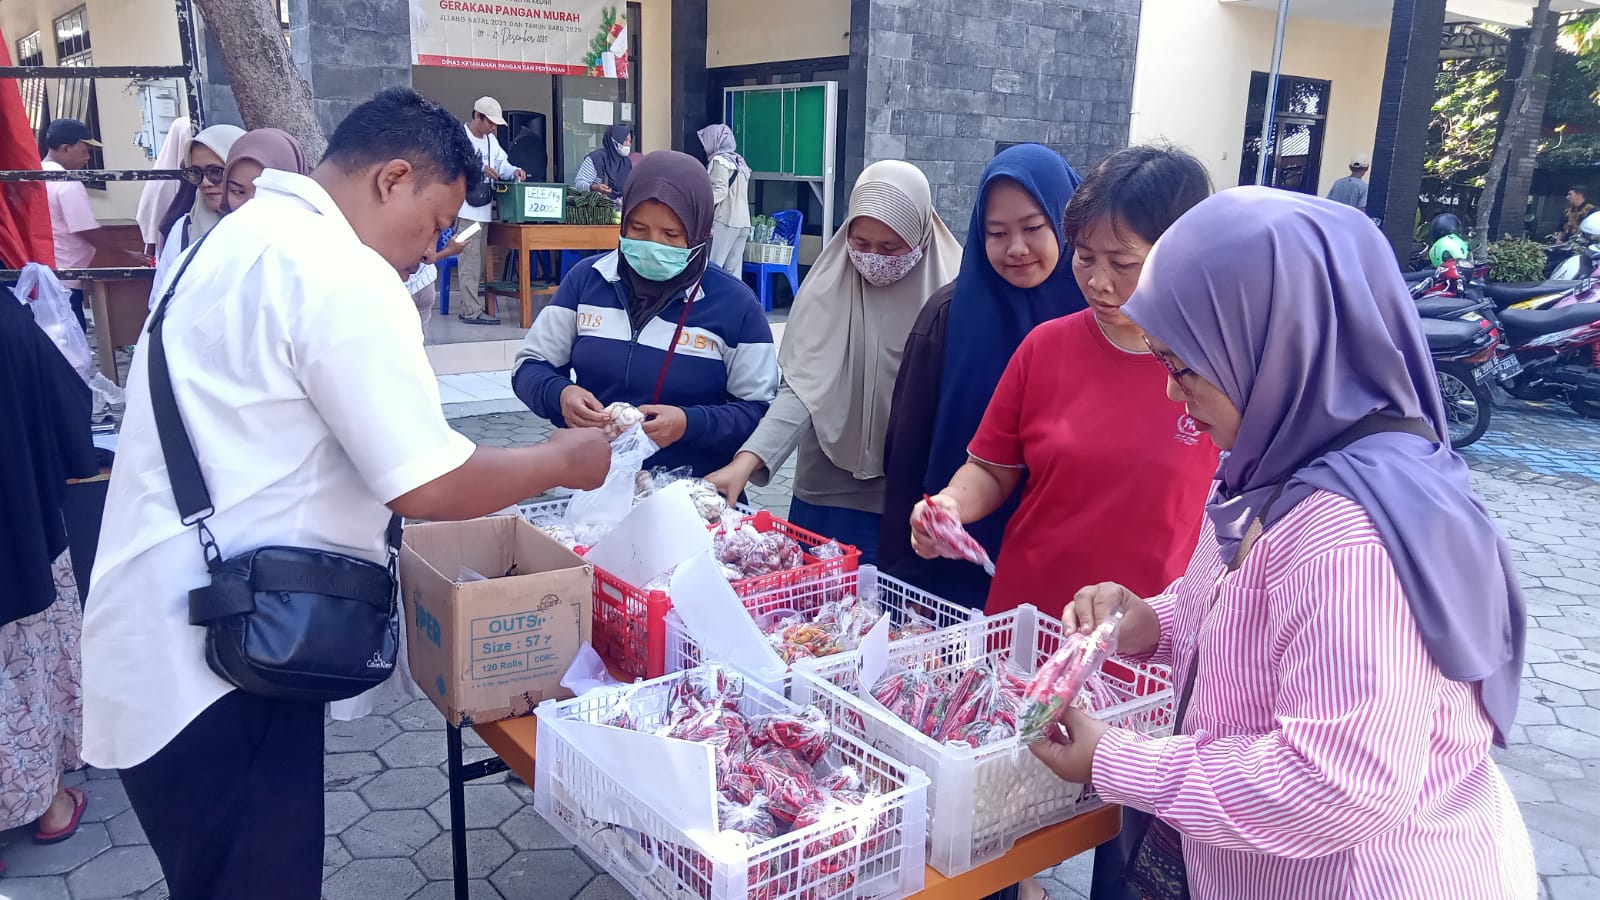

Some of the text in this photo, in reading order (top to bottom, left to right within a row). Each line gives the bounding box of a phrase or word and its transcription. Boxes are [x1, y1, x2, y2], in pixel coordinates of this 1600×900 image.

[440, 0, 580, 23] GERAKAN PANGAN MURAH
[467, 17, 489, 25] NATAL
[548, 24, 564, 32] BARU
[461, 60, 497, 68] KETAHANAN
[535, 65, 566, 73] PERTANIAN
[482, 641, 512, 655] Size
[525, 634, 541, 648] 57
[482, 663, 498, 673] 120
[500, 659, 523, 670] Rolls
